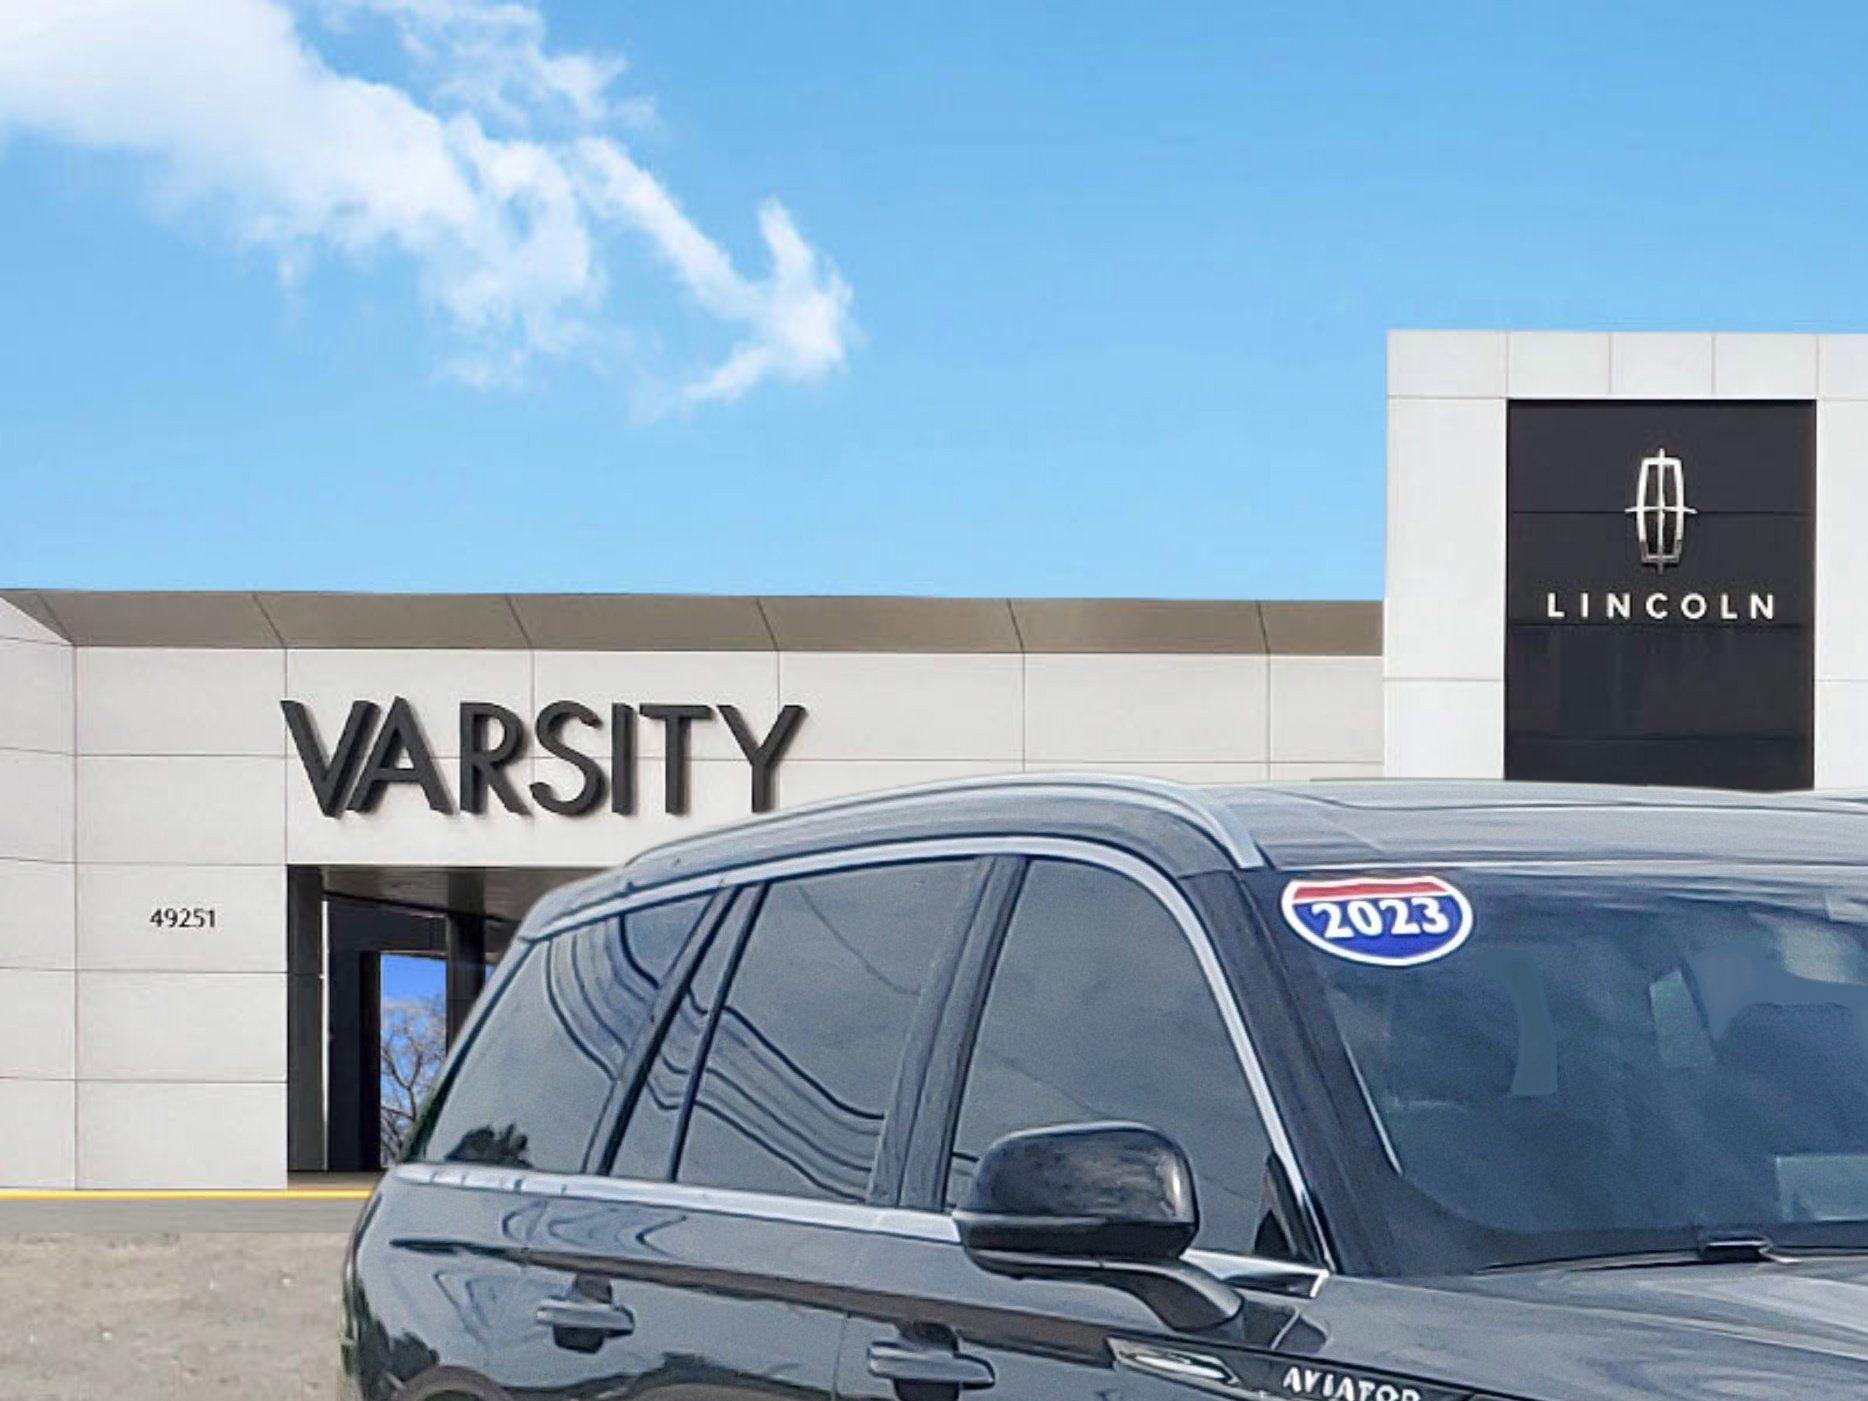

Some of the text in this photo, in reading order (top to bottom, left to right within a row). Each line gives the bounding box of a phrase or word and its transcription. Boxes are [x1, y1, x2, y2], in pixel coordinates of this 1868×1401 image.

[1547, 592, 1774, 619] LINCOLN
[280, 696, 807, 817] VARSITY
[149, 908, 215, 928] 49251
[1311, 897, 1450, 938] 2023
